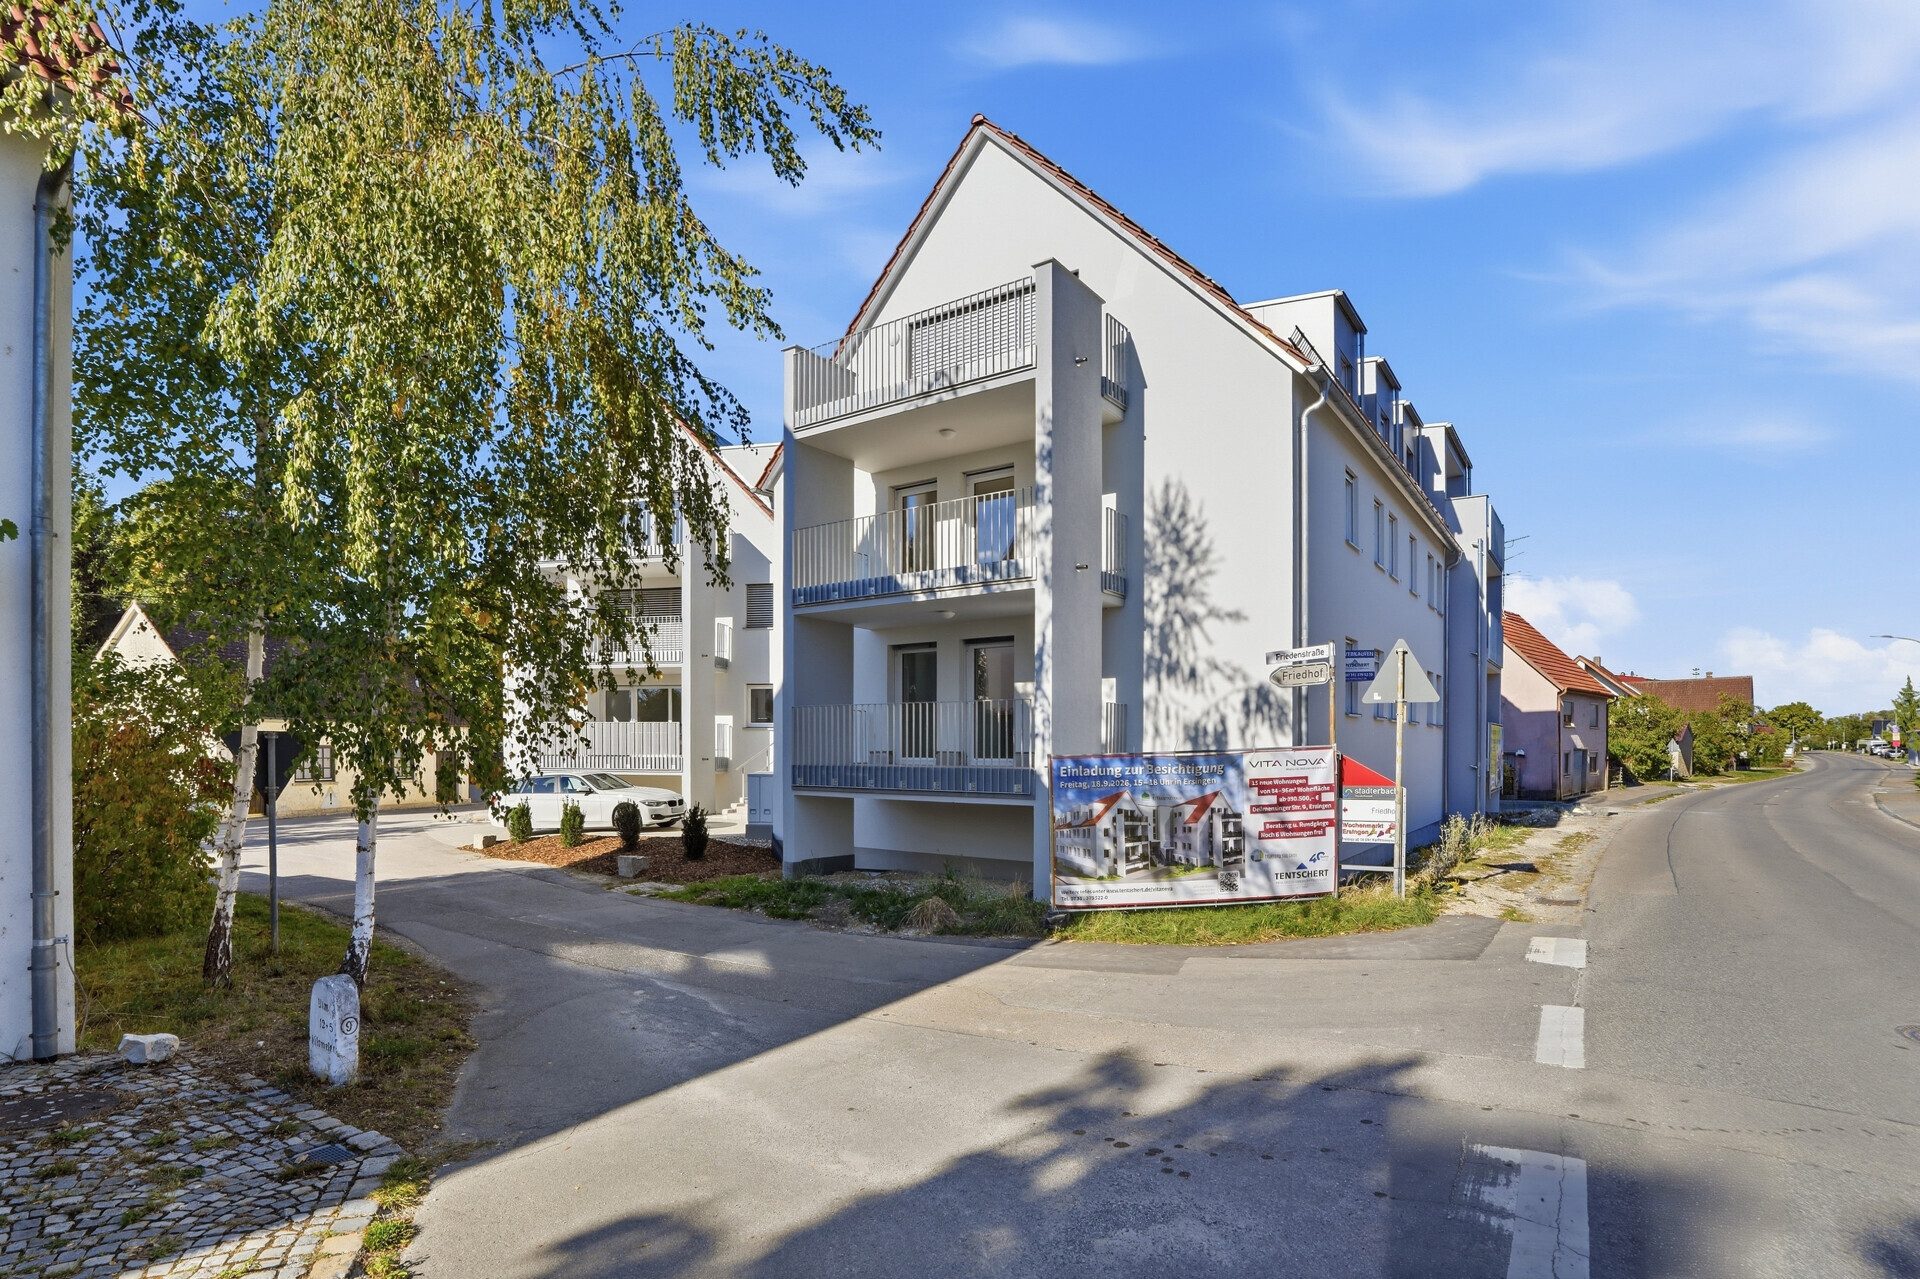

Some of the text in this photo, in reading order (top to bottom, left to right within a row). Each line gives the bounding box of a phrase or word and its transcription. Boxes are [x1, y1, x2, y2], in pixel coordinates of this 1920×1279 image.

[1276, 648, 1325, 660] Friedenstraße
[1282, 668, 1324, 681] Friedhof
[1249, 758, 1327, 768] VITA NOVA
[1060, 764, 1225, 778] Einladung zur Besichtigung
[1060, 780, 1090, 789] Freitag,
[1183, 778, 1217, 787] Ersingen
[1297, 785, 1330, 793] Wohnfläche
[1371, 807, 1396, 815] Friedho
[1299, 820, 1329, 828] Rundgänge
[1275, 869, 1329, 880] TENTSCHERT
